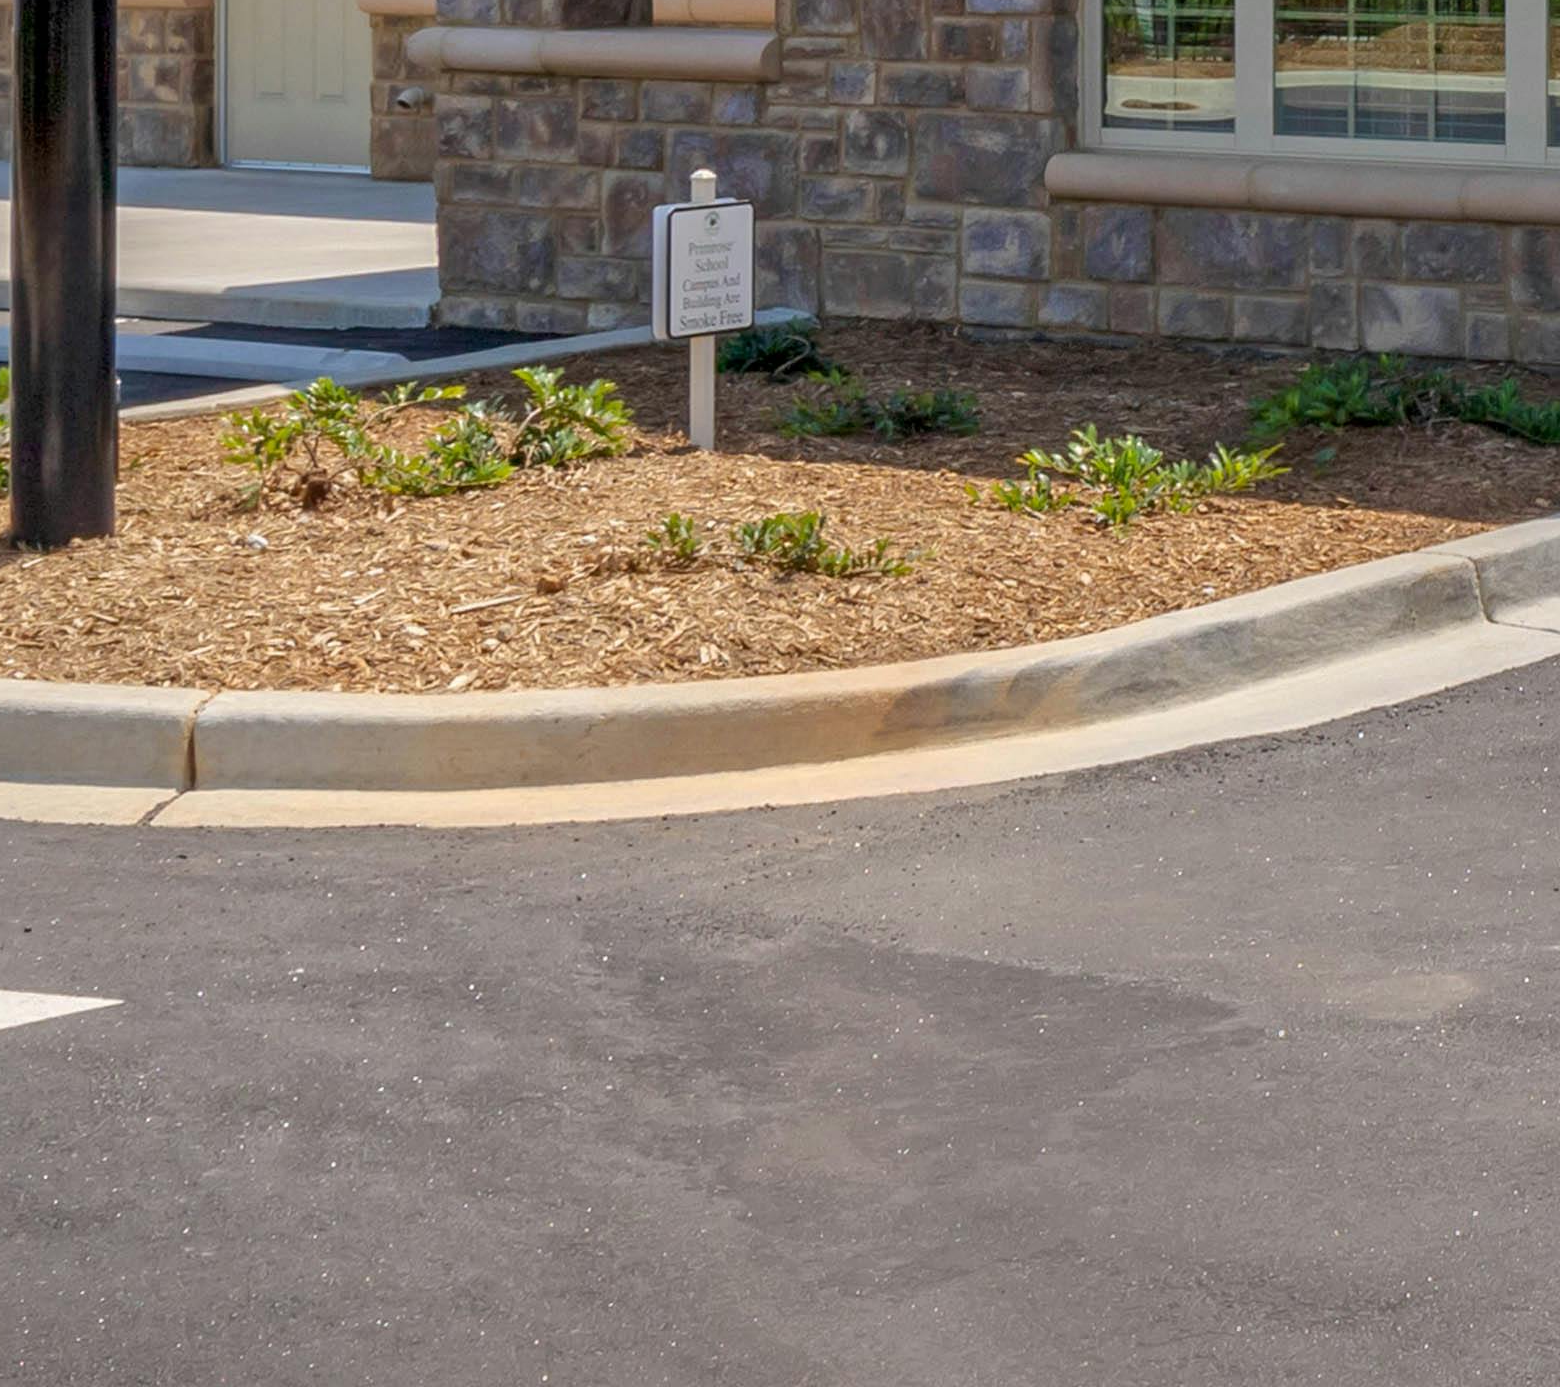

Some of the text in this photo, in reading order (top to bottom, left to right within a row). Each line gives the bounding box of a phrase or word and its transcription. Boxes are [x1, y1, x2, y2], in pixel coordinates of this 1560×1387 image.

[695, 255, 729, 273] School
[680, 309, 743, 331] Smoke Free
